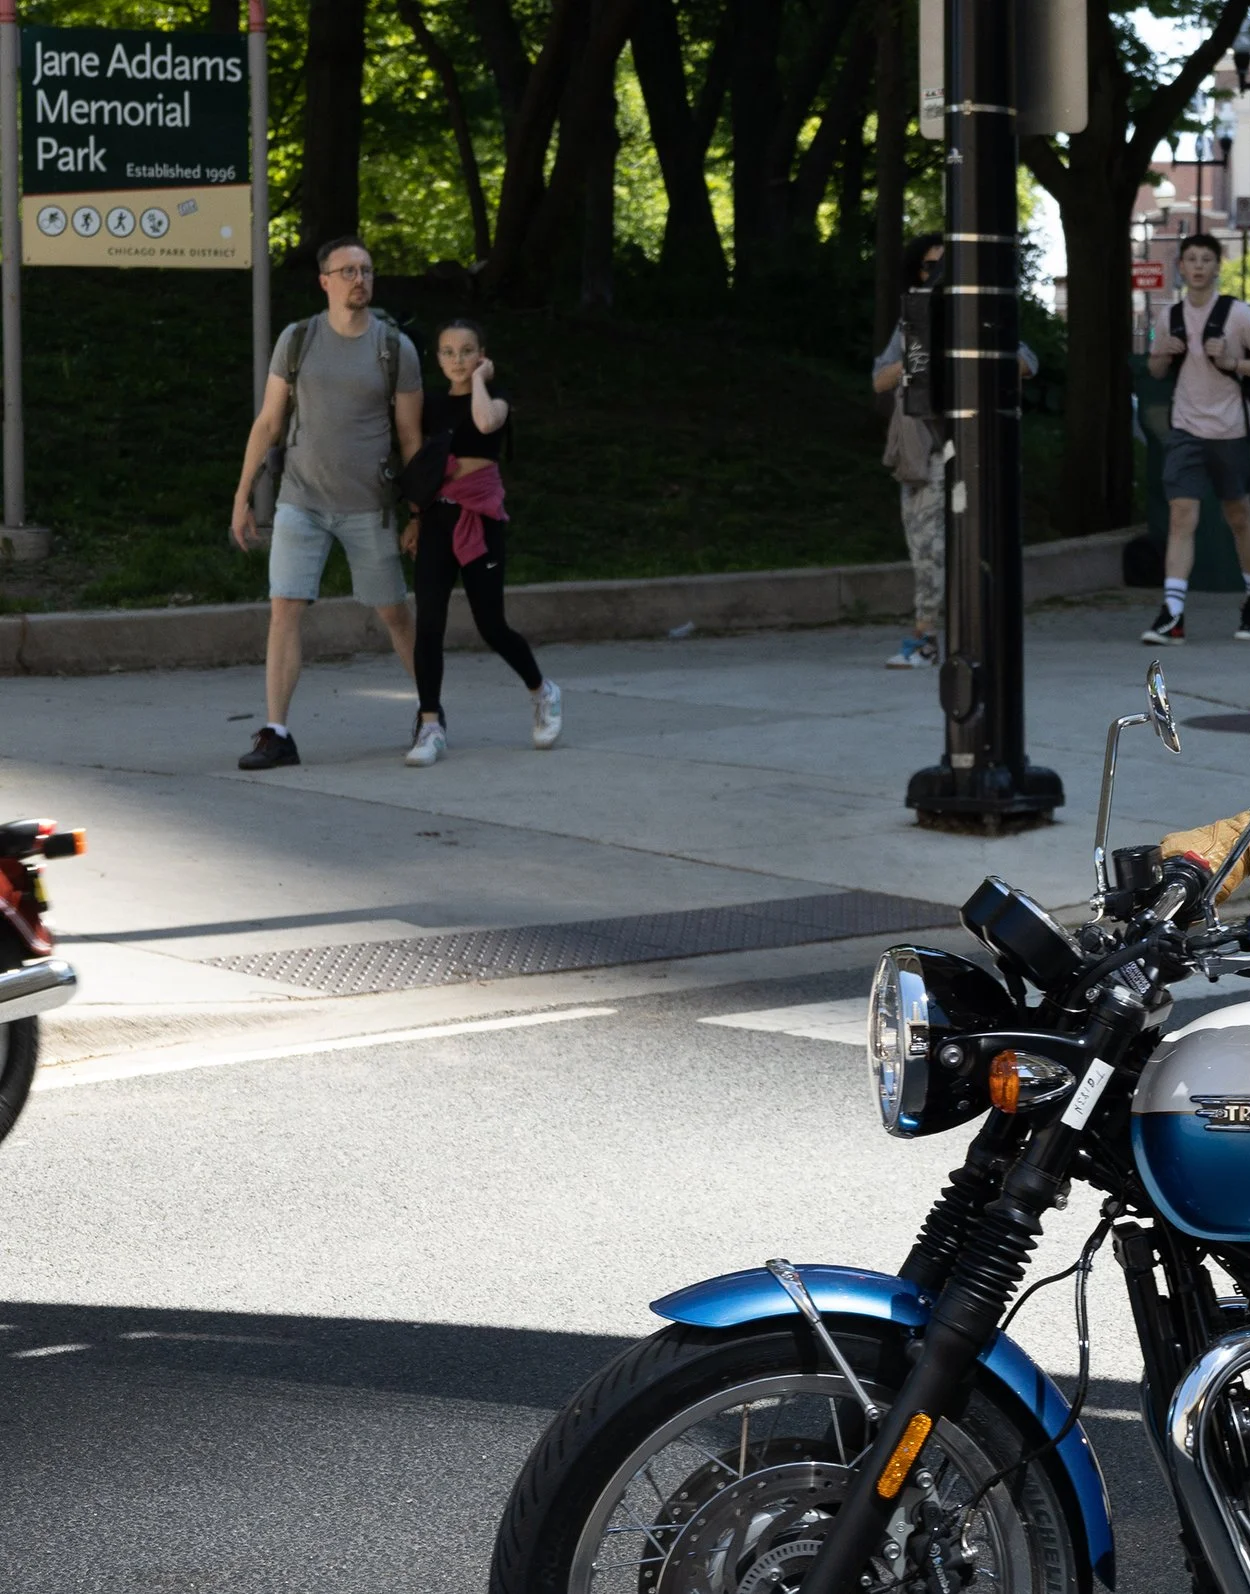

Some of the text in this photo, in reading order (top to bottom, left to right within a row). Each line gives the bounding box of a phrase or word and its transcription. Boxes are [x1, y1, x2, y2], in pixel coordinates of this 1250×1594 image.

[32, 41, 243, 86] Jane Addams
[36, 89, 190, 128] Memorial
[37, 135, 107, 173] Park
[126, 163, 236, 183] Established 1996
[107, 247, 236, 258] CHICAGO PARK DISTRICT
